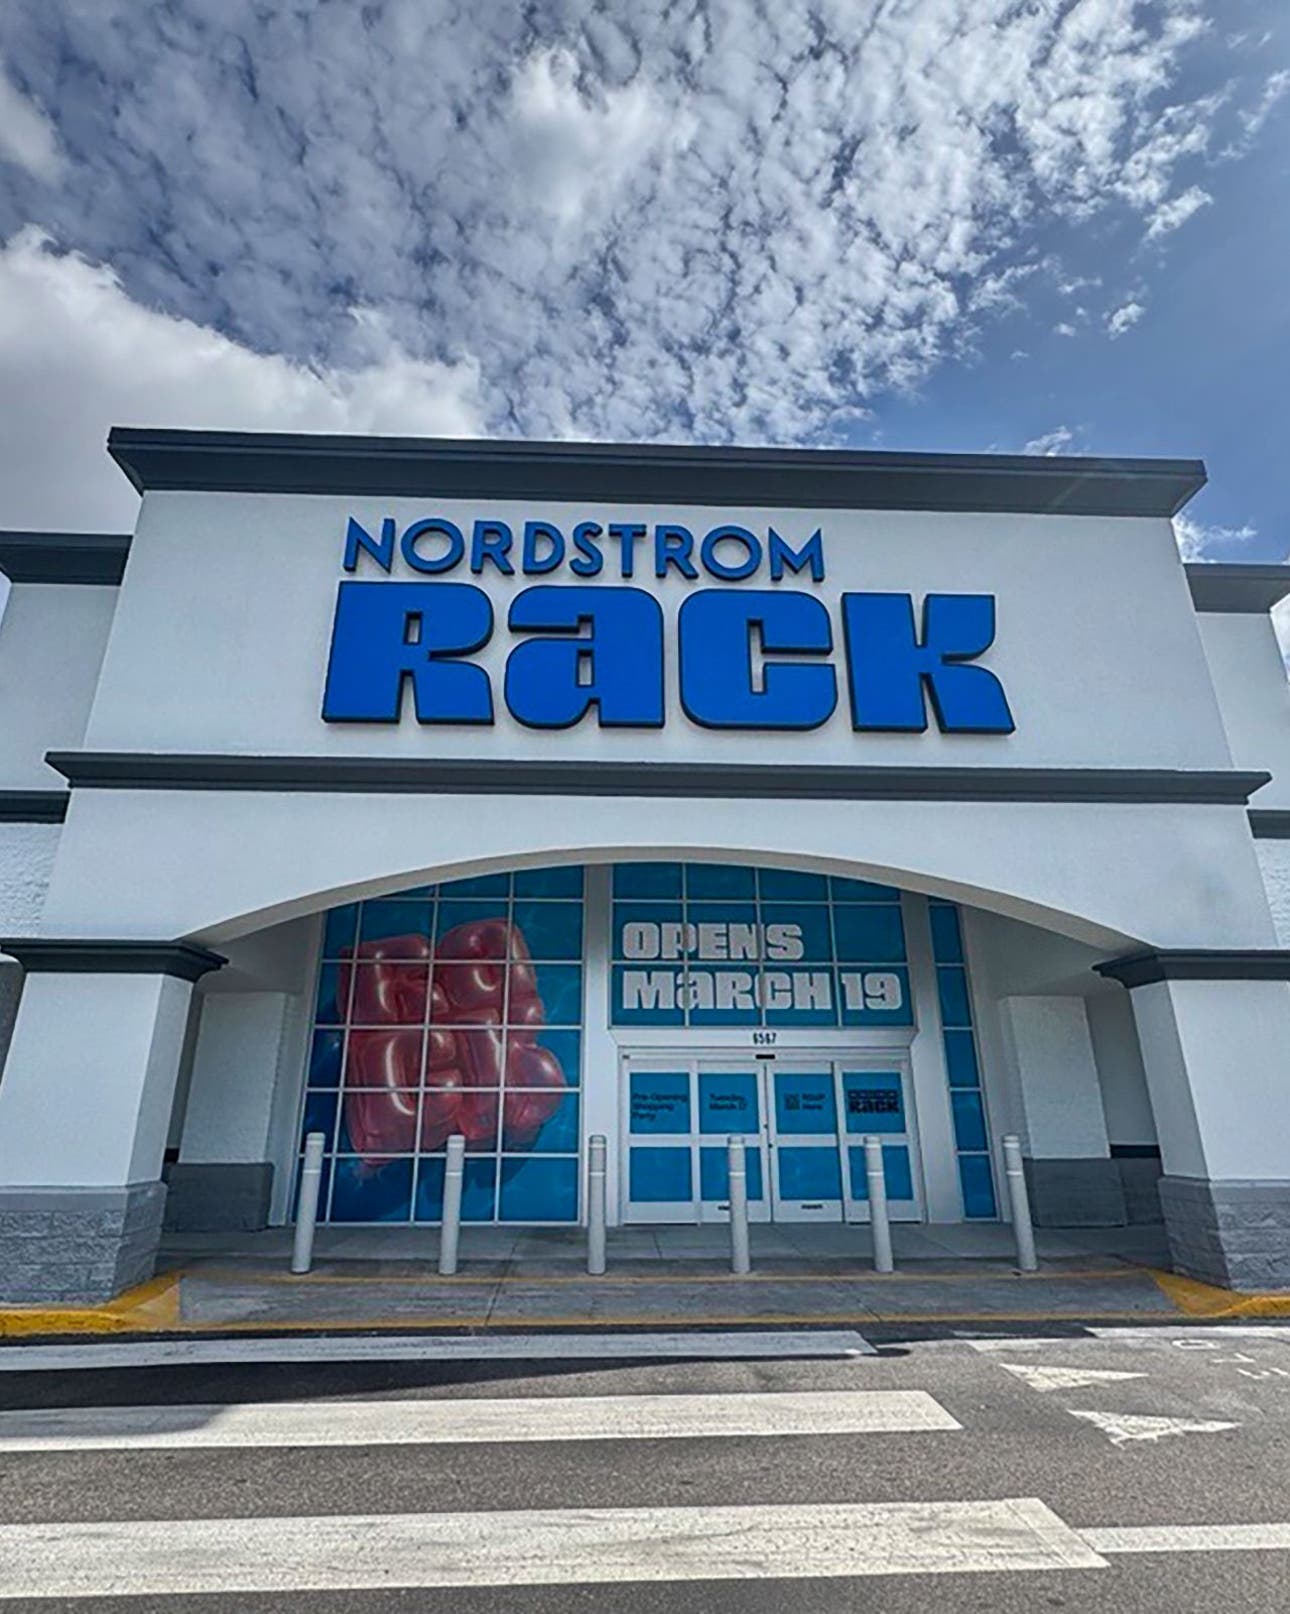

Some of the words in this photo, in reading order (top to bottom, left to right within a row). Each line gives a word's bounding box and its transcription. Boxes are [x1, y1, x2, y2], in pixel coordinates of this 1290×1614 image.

[344, 516, 825, 583] NORDSTROM
[622, 921, 805, 960] OPENS
[841, 972, 902, 1010] 19
[753, 1032, 777, 1045] 6567
